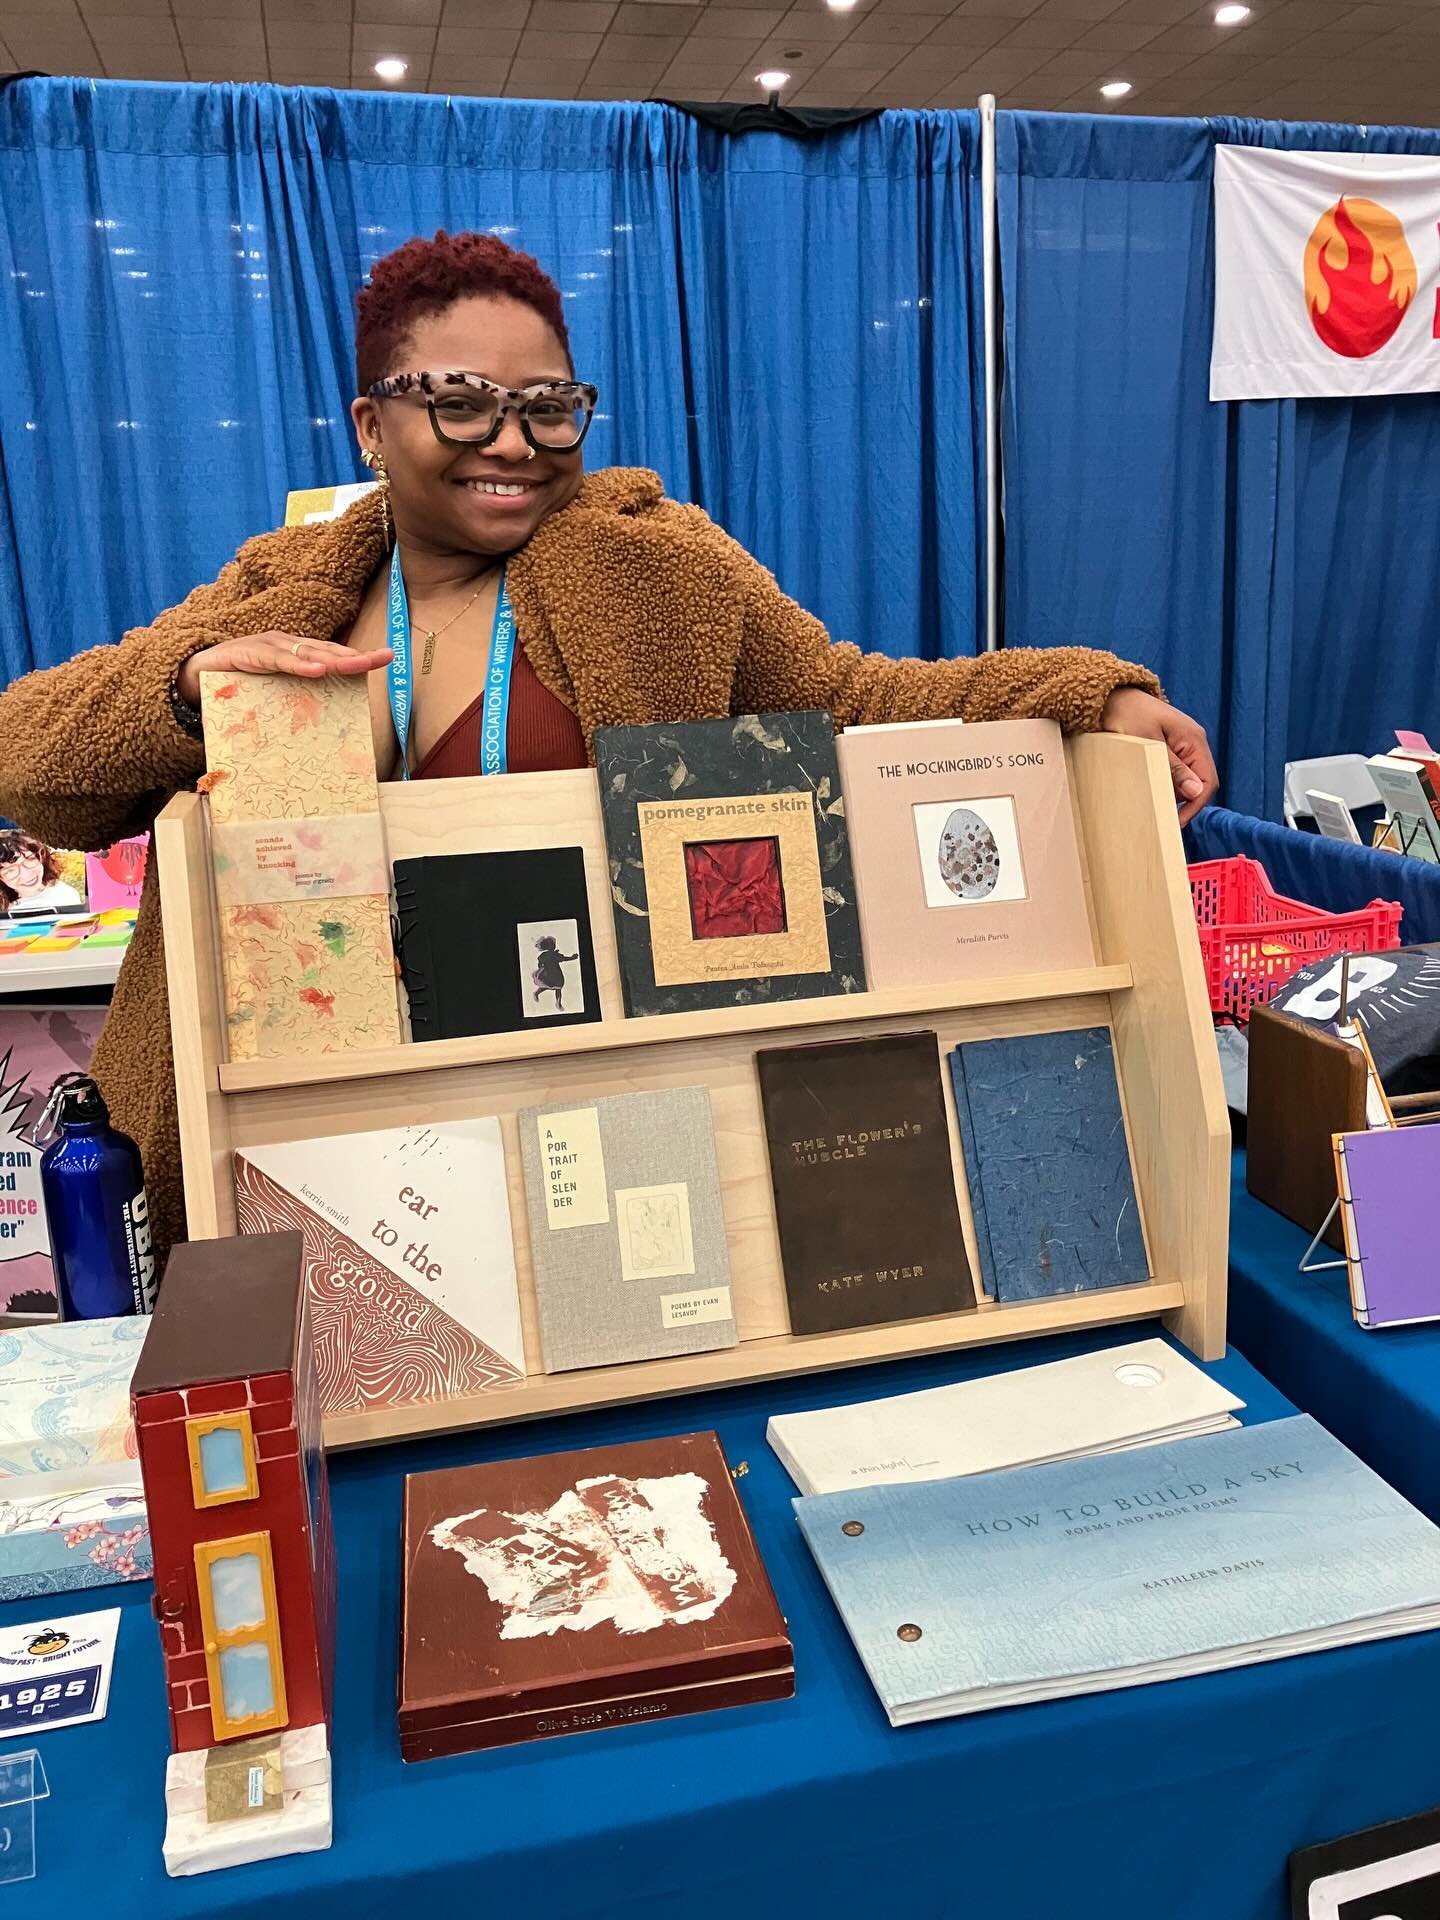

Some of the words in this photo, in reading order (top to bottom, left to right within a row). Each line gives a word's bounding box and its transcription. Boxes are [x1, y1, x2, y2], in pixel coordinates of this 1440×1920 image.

[393, 614, 404, 630] OF
[499, 609, 512, 619] &
[493, 621, 511, 665] WRITERS
[393, 630, 406, 675] WRITERS
[394, 677, 407, 686] &
[491, 666, 504, 684] OF
[485, 687, 503, 776] ASSOCIATION
[877, 764, 902, 779] THE
[907, 755, 1003, 776] MOCKINGBIRD'S
[1008, 753, 1044, 767] SONG
[643, 801, 766, 824] pomegranate
[771, 798, 808, 812] skin
[255, 836, 284, 844] sounds
[256, 844, 292, 852] achieved
[257, 854, 267, 862] by
[258, 860, 296, 869] knocking
[956, 935, 986, 944] Meredith
[987, 933, 1009, 942] Purvis
[546, 1129, 553, 1139] A
[547, 1141, 568, 1152] POR
[791, 1137, 826, 1153] THE
[549, 1154, 578, 1166] TRAIT
[793, 1145, 866, 1166] MUSCLE
[550, 1170, 563, 1180] OF
[552, 1182, 577, 1194] SLEN
[300, 1184, 326, 1209] kerrin
[325, 1205, 350, 1227] smith
[398, 1186, 439, 1220] ear
[553, 1197, 573, 1208] DER
[122, 1202, 130, 1220] THE
[125, 1221, 138, 1274] UNIVERSITY
[371, 1219, 399, 1246] to
[403, 1242, 442, 1281] the
[132, 1275, 139, 1287] OF
[818, 1274, 863, 1292] KATE
[876, 1265, 924, 1282] WYER
[330, 1260, 429, 1330] ground
[671, 1301, 692, 1311] POEMS
[693, 1300, 701, 1308] BY
[702, 1298, 719, 1306] EVAN
[671, 1309, 698, 1319] LESAVOY
[859, 1465, 880, 1473] thin
[880, 1460, 905, 1470] light
[967, 1511, 1041, 1537] HOW
[1056, 1503, 1101, 1523] TO
[1113, 1483, 1208, 1512] BUILD
[1223, 1476, 1242, 1491] A
[1250, 1460, 1306, 1483] SKY
[1064, 1520, 1112, 1537] POEMS
[1115, 1514, 1144, 1528] AND
[1147, 1505, 1190, 1521] PROSE
[1192, 1495, 1239, 1512] POEMS
[1142, 1567, 1219, 1591] KATHLEEN
[1221, 1558, 1265, 1575] DAVIS
[42, 1650, 71, 1662] BRIGHT
[72, 1639, 102, 1654] FUTURE
[0, 1680, 87, 1710] 1925
[605, 1709, 616, 1720] V
